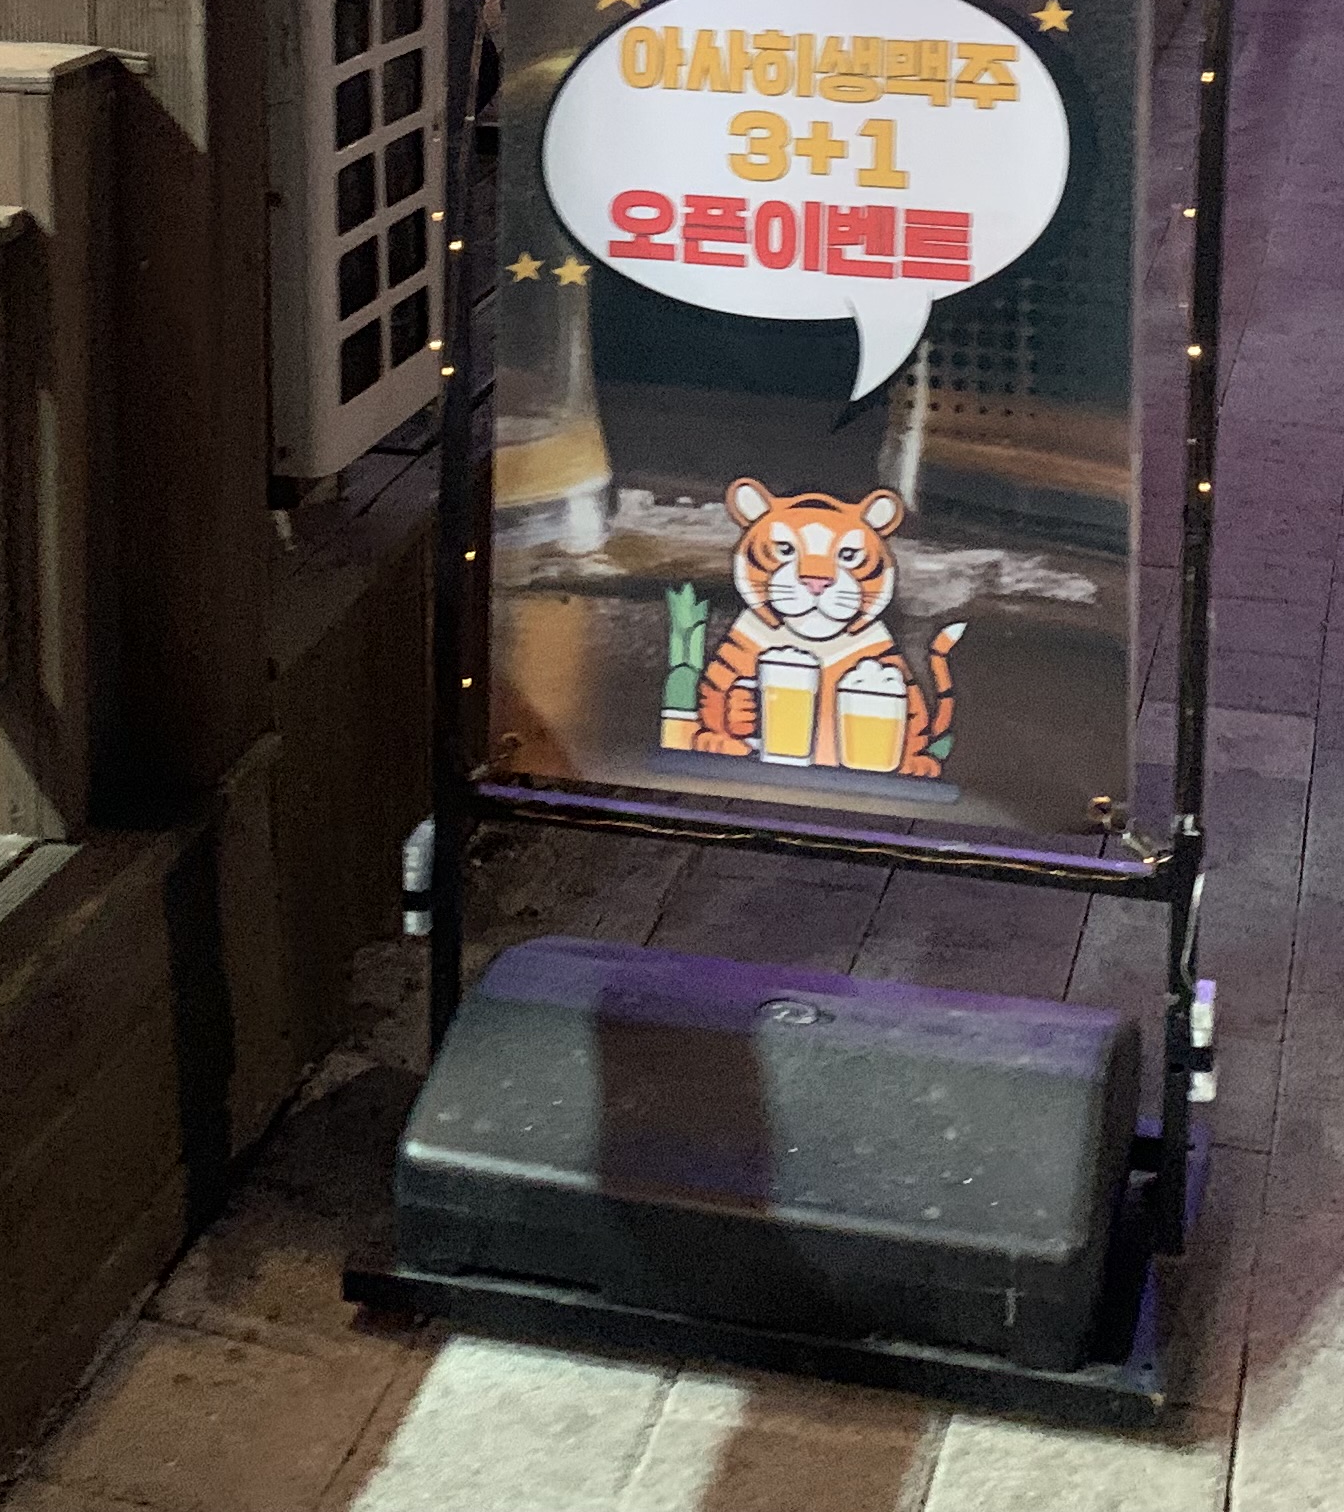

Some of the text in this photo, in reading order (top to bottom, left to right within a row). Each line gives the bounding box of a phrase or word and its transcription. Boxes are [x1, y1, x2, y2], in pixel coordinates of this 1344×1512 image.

[619, 26, 1020, 109] 아사히생맥주
[727, 109, 910, 189] 3+1
[607, 189, 975, 281] 오픈이벤트
